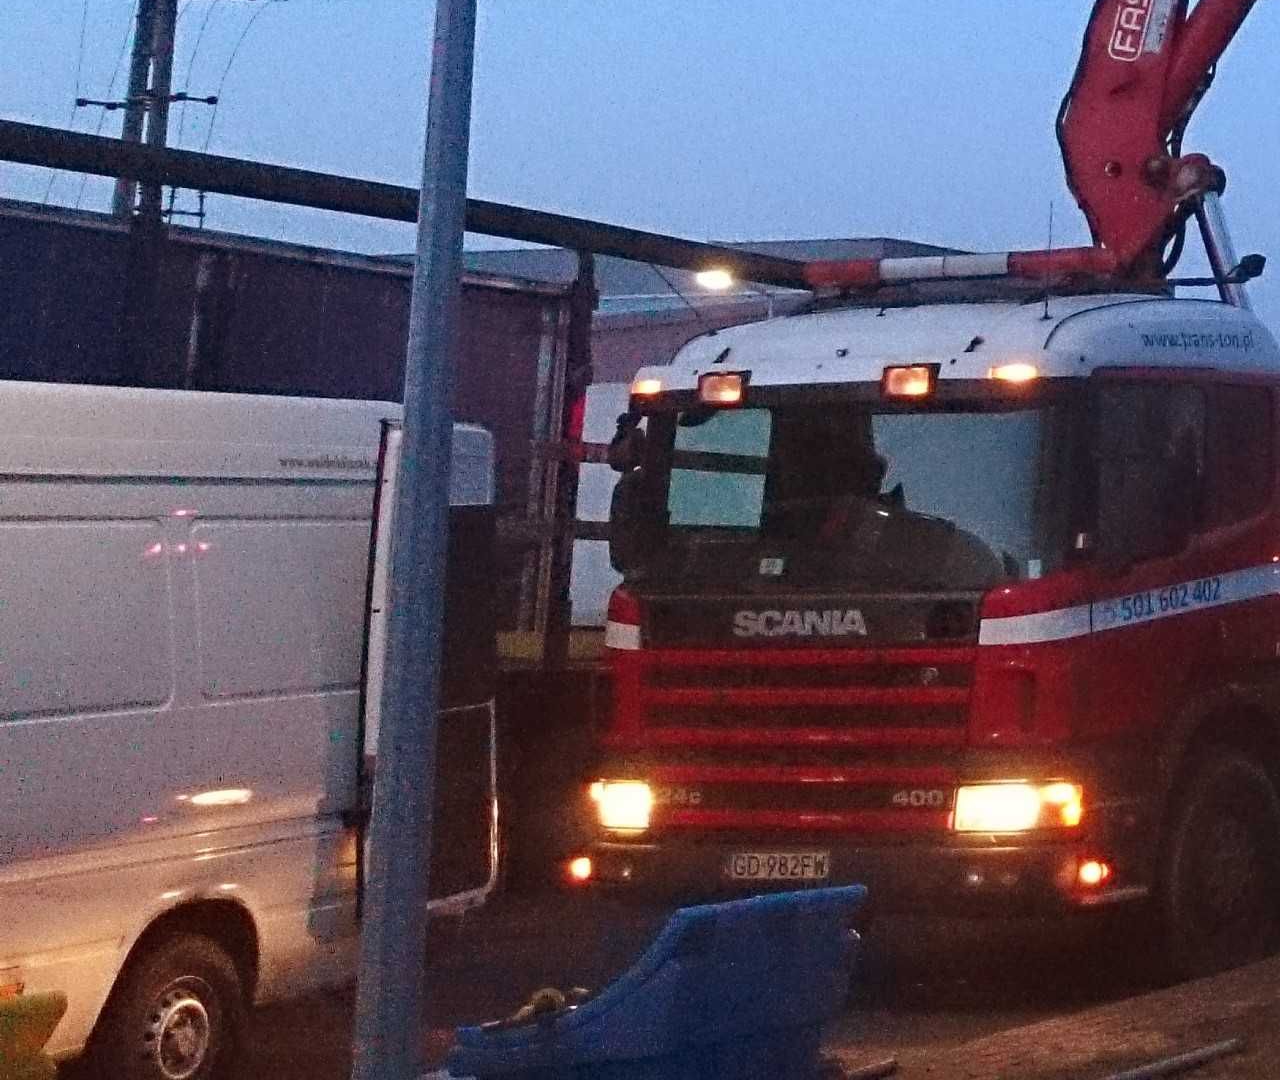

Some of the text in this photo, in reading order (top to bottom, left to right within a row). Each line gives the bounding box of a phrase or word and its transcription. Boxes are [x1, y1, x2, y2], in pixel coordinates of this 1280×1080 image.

[1121, 591, 1154, 621] 501
[1160, 585, 1189, 612] 602
[733, 610, 867, 637] SCANIA
[892, 789, 944, 806] 400
[735, 855, 760, 876] GD
